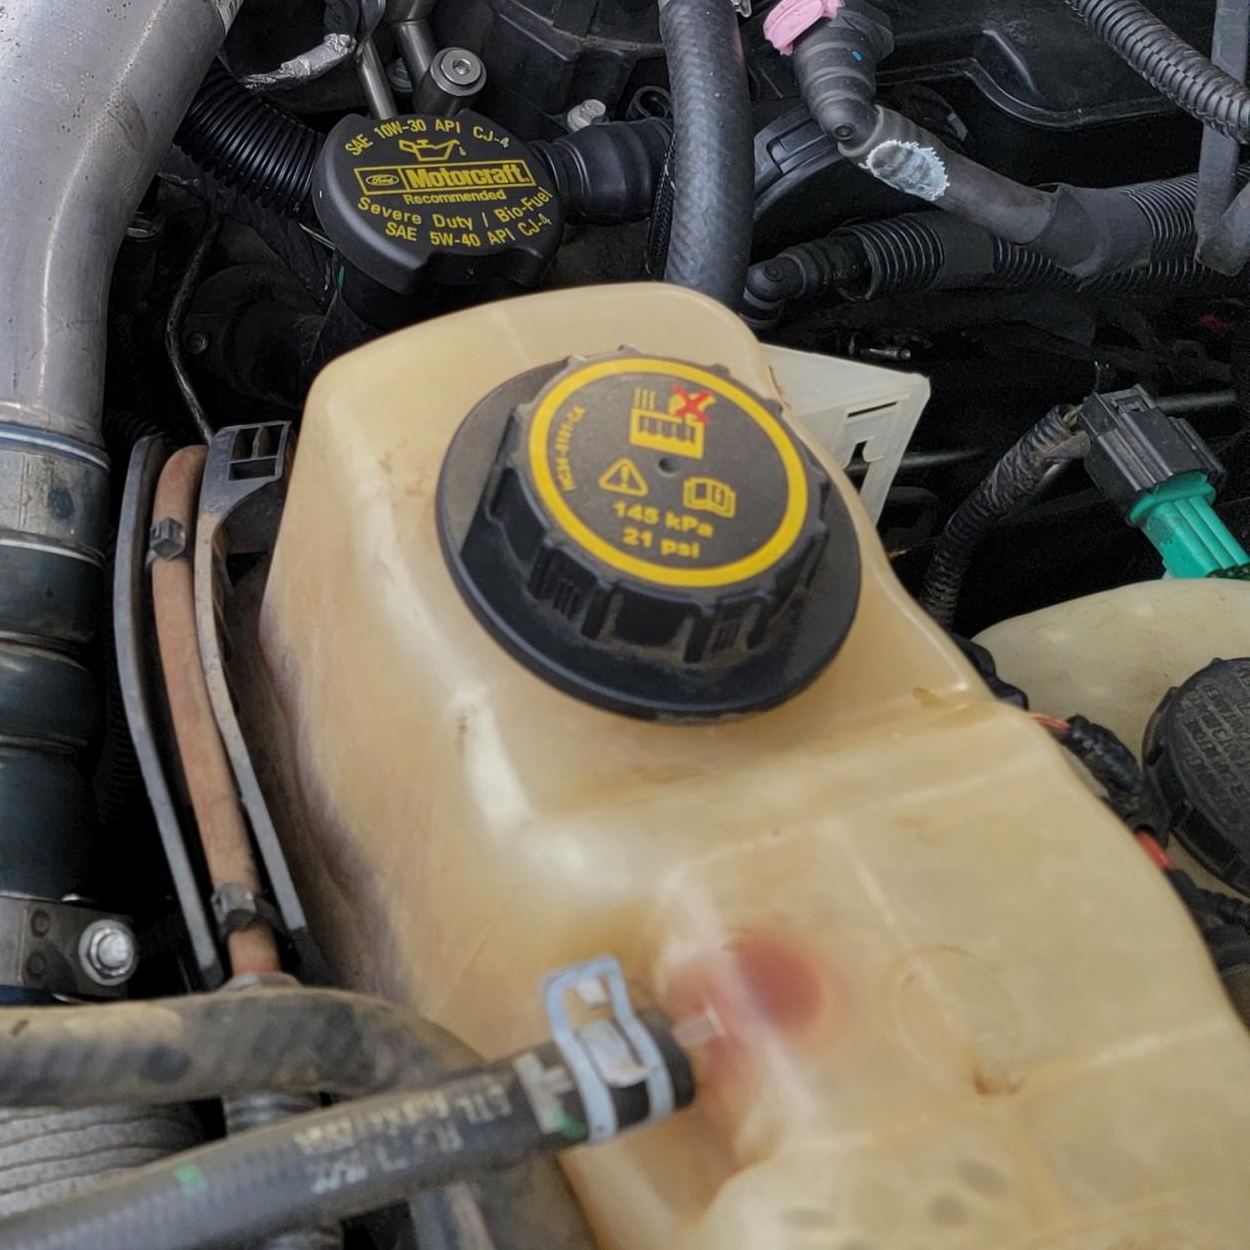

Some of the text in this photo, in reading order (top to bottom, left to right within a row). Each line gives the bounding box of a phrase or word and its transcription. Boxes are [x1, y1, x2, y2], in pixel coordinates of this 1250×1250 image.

[345, 118, 510, 156] SAE 10W-30 API CJ-4
[357, 197, 422, 225] Severe
[432, 214, 473, 231] Duty
[494, 187, 553, 223] Bio-Fuel
[403, 190, 508, 205] Recommended
[385, 213, 552, 247] SAE 5W-40 API CJ-4
[613, 502, 714, 538] 145 kPa
[622, 527, 700, 559] 21 psi
